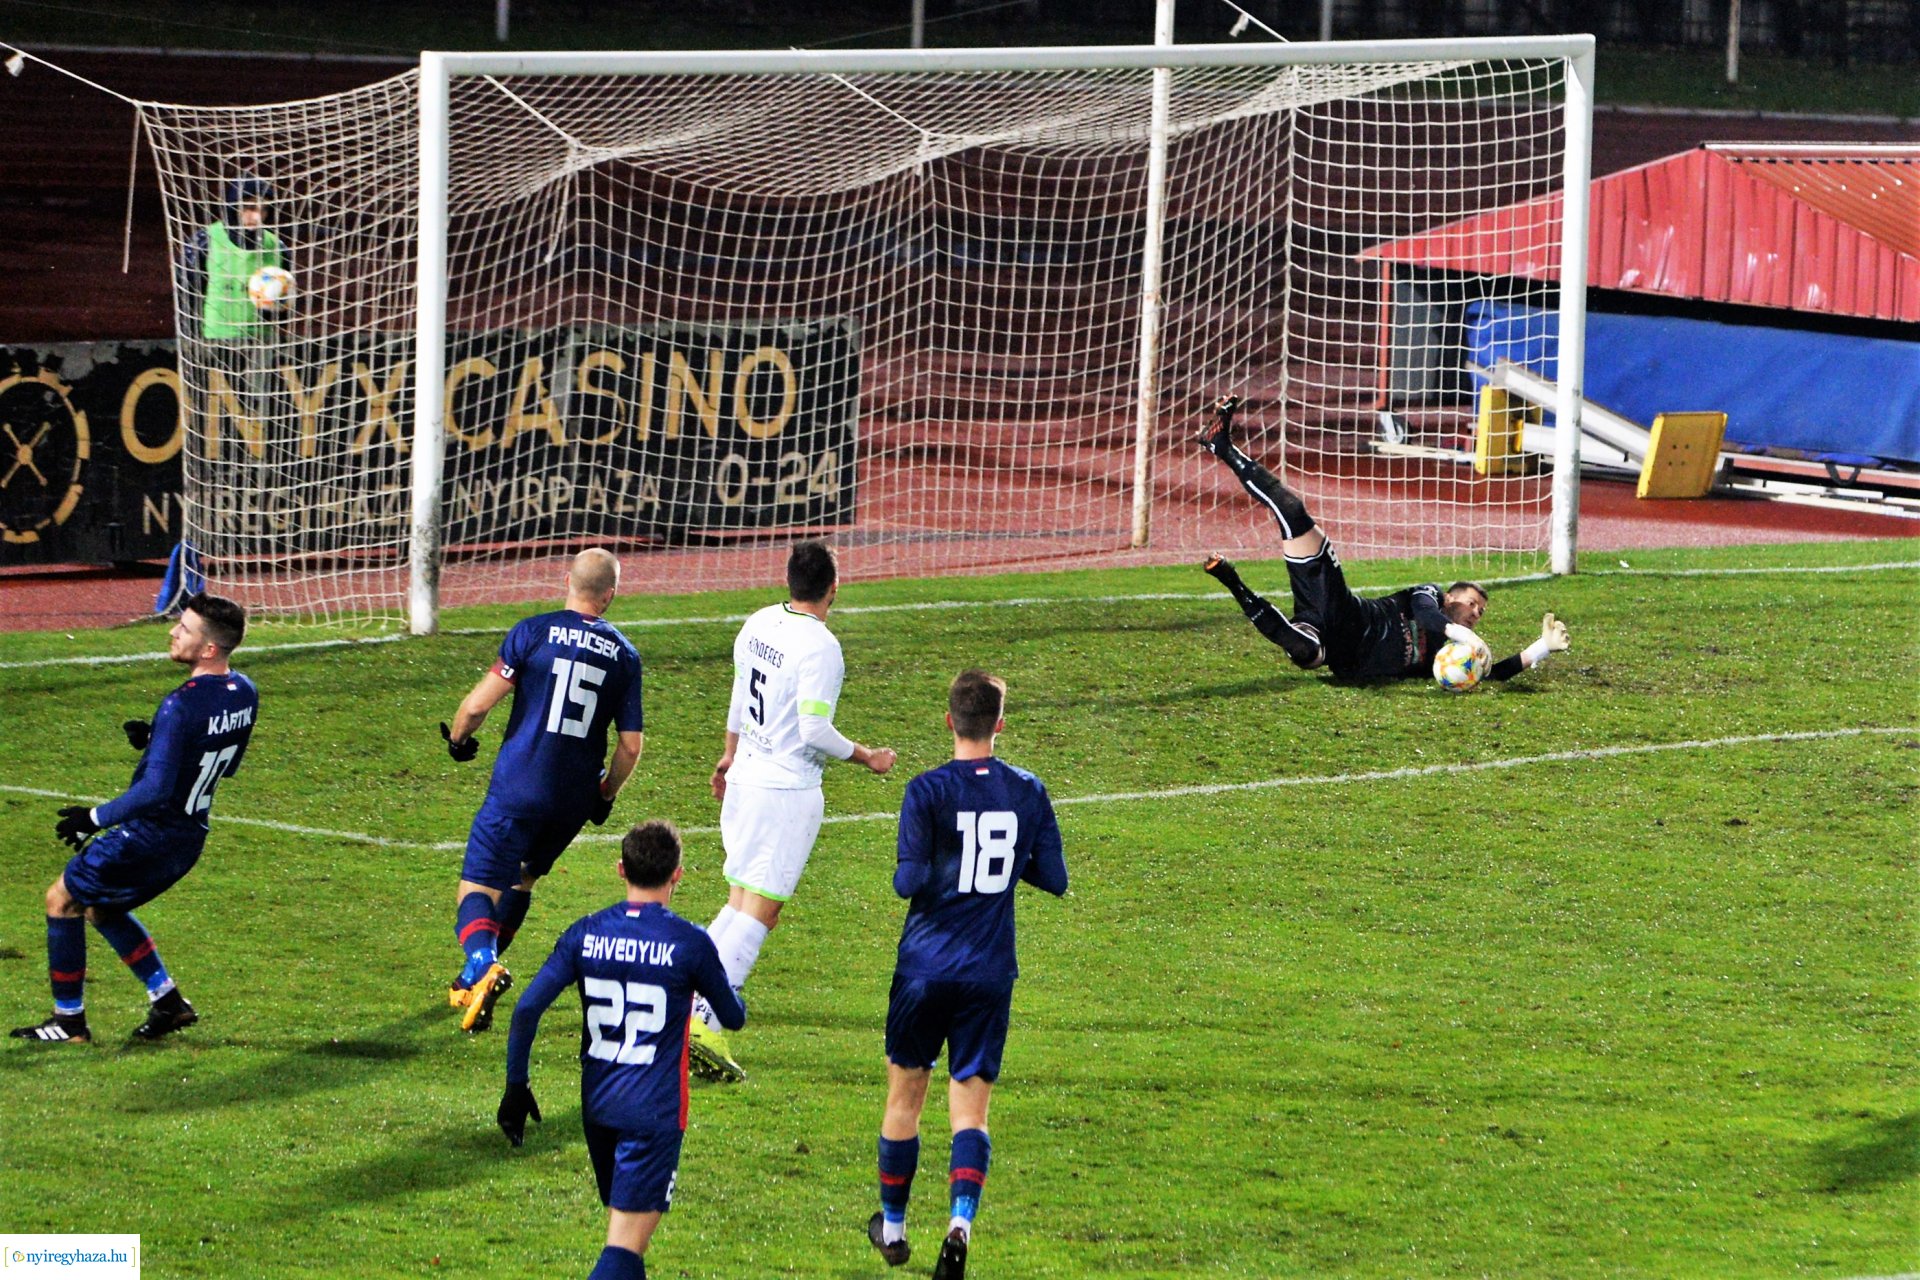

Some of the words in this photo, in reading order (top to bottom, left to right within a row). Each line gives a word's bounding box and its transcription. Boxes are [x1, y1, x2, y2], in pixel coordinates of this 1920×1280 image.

[120, 362, 411, 464] ONYX
[444, 345, 797, 452] CASINO
[143, 483, 412, 535] NYIREGYHAZ
[455, 469, 662, 523] NYIRPAZA
[716, 451, 838, 506] 0-24
[548, 625, 620, 661] PAPUCSEK
[546, 657, 607, 739] 15
[749, 667, 767, 726] 5
[184, 744, 238, 816] 10
[956, 811, 1019, 894] 18
[581, 933, 675, 967] SHVEDYUK
[584, 976, 667, 1065] 22
